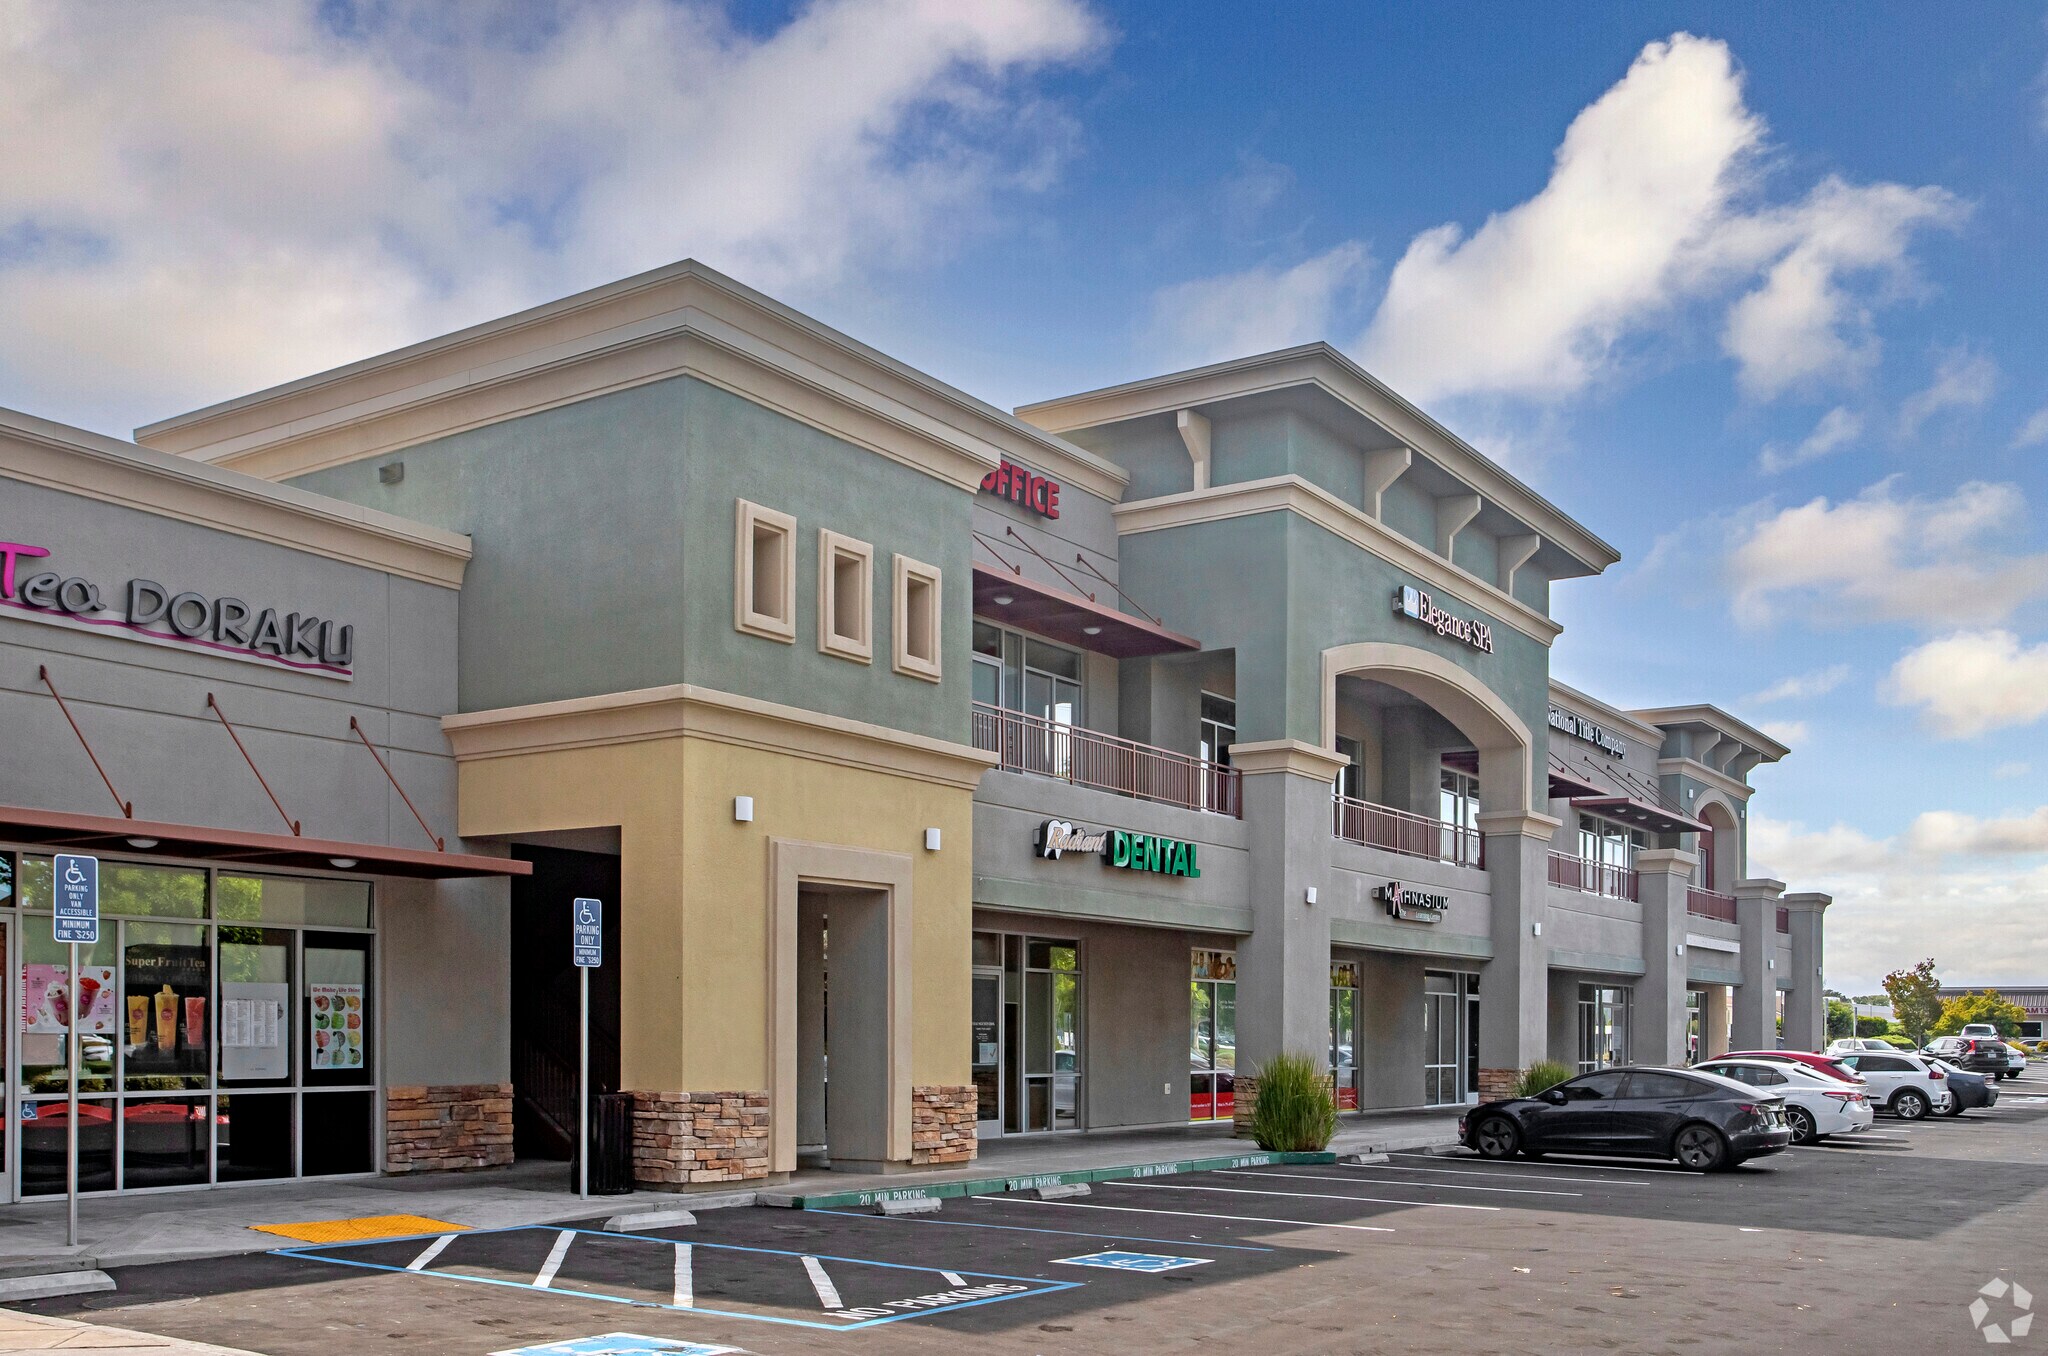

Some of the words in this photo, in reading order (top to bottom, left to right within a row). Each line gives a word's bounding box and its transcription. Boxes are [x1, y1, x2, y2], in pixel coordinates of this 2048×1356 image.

[126, 577, 353, 665] DORAKU
[1419, 590, 1471, 642] Elegance
[1471, 620, 1494, 654] SPA
[1577, 717, 1595, 743] Title
[1595, 726, 1626, 760] Company
[1047, 827, 1108, 853] Radiant
[1110, 830, 1201, 878] DENTAL
[64, 884, 88, 892] PARKING
[60, 908, 93, 916] ACCESSIBLE
[62, 920, 90, 929] MINIMUM
[575, 924, 600, 935] PARKING
[57, 929, 72, 939] FINE
[580, 935, 595, 945] ONLY
[126, 956, 156, 968] Super
[157, 956, 187, 968] Fruit
[187, 957, 206, 968] Tea
[576, 956, 586, 964] FINE
[1231, 1159, 1239, 1168] 20
[1240, 1157, 1249, 1167] MIN
[1250, 1155, 1269, 1166] PARKING
[1132, 1168, 1140, 1178] 20
[1142, 1165, 1153, 1176] MIN
[1155, 1163, 1177, 1175] PARKING
[1009, 1180, 1018, 1191] 20
[1020, 1178, 1033, 1190] MIN
[1035, 1175, 1062, 1188] PARKING
[859, 1194, 871, 1206] 20
[874, 1192, 890, 1201] MIN
[893, 1189, 926, 1201] PARKING
[821, 1307, 896, 1320] NO
[881, 1283, 1028, 1309] PARKING
